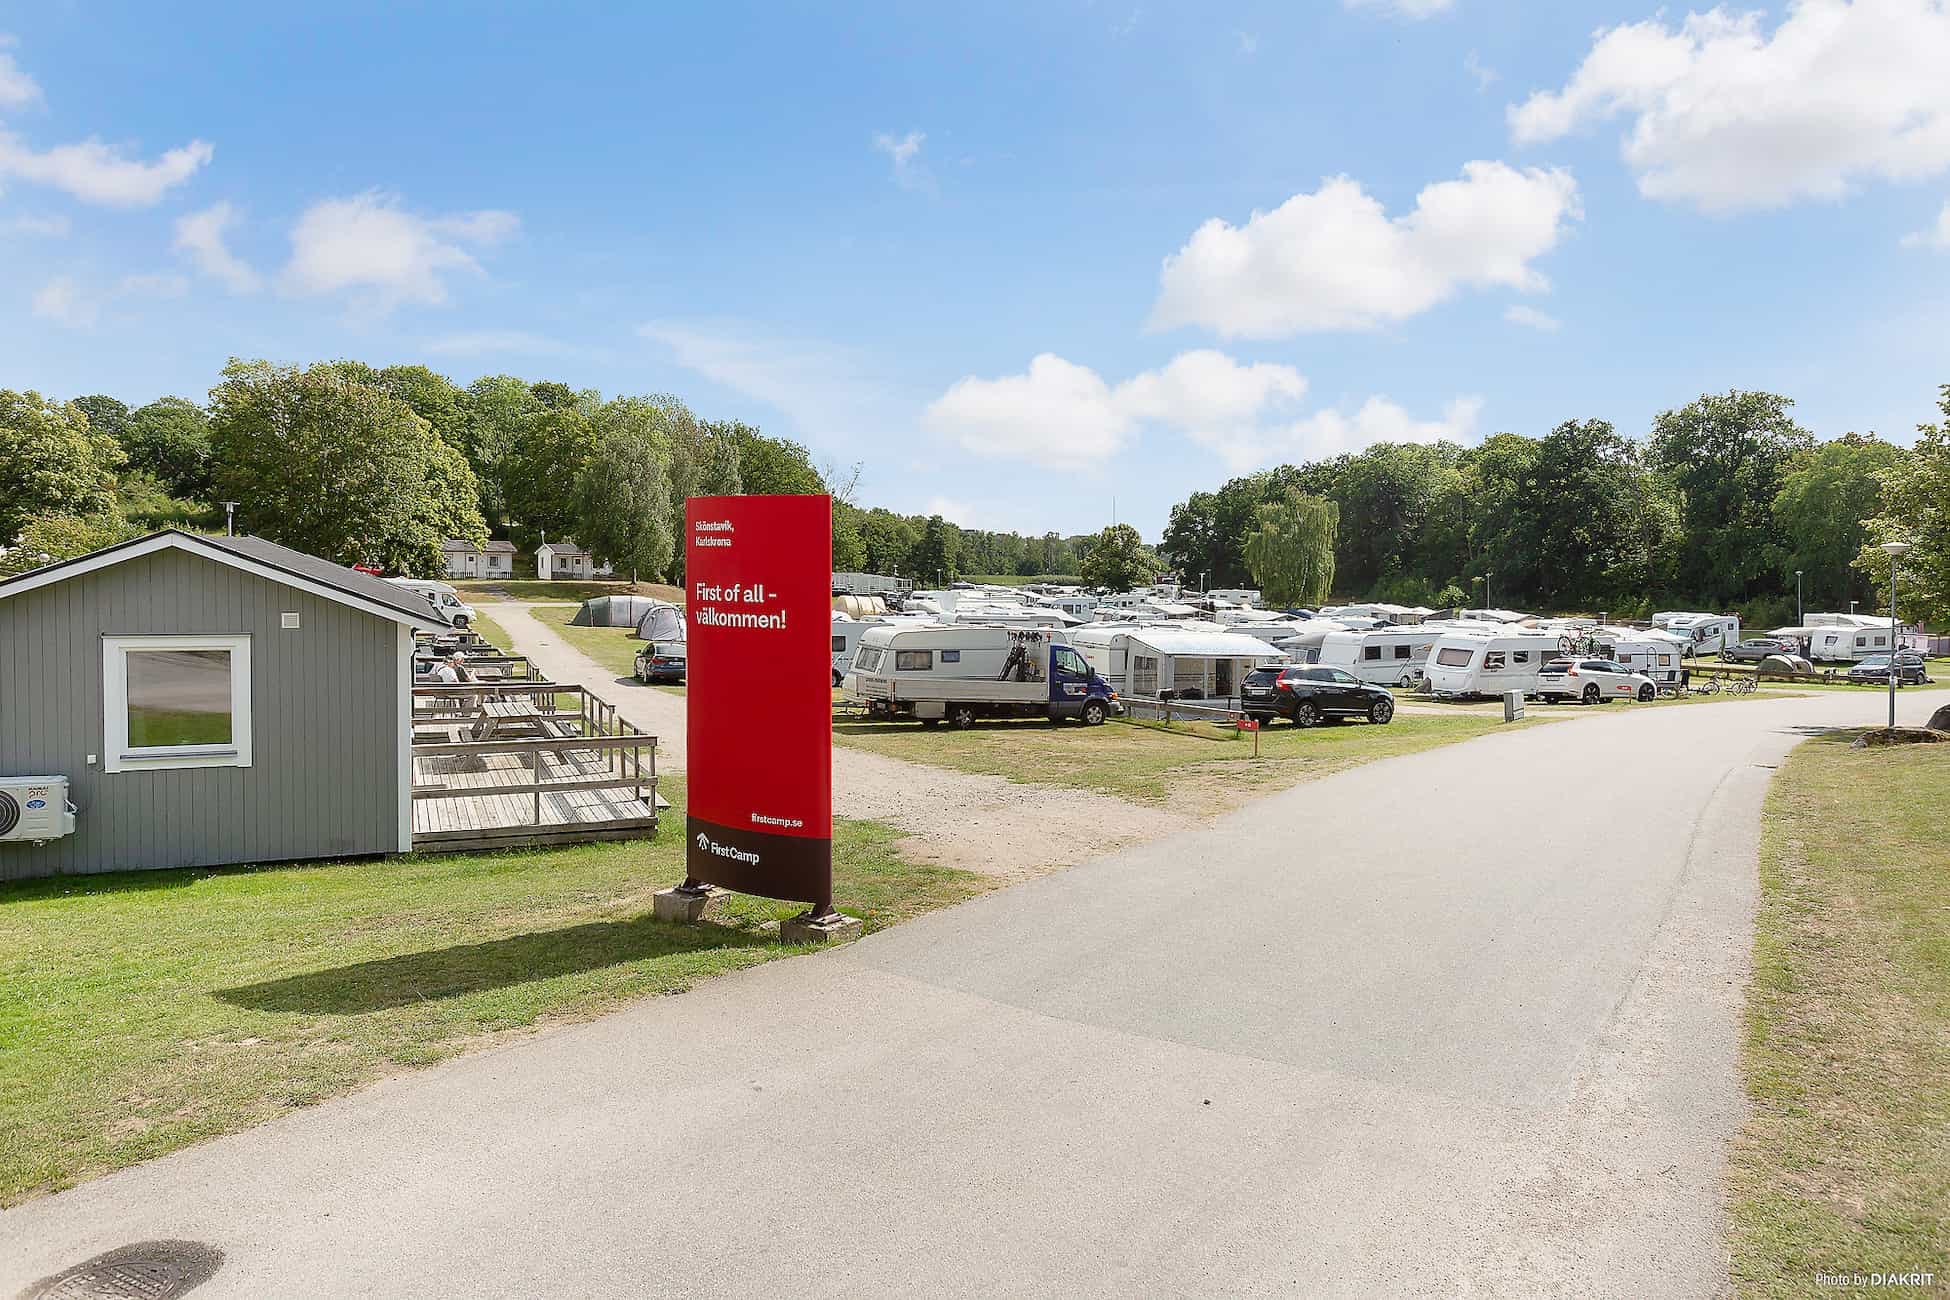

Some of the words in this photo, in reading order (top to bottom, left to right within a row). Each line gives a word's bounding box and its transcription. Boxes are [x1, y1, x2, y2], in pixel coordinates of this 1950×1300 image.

[695, 520, 735, 532] Skönstavik,
[695, 536, 732, 547] Karlskrona
[696, 582, 722, 601] First
[724, 584, 740, 602] of
[743, 584, 764, 603] all
[696, 607, 787, 629] välkommen!
[751, 813, 803, 828] firstcamp.se
